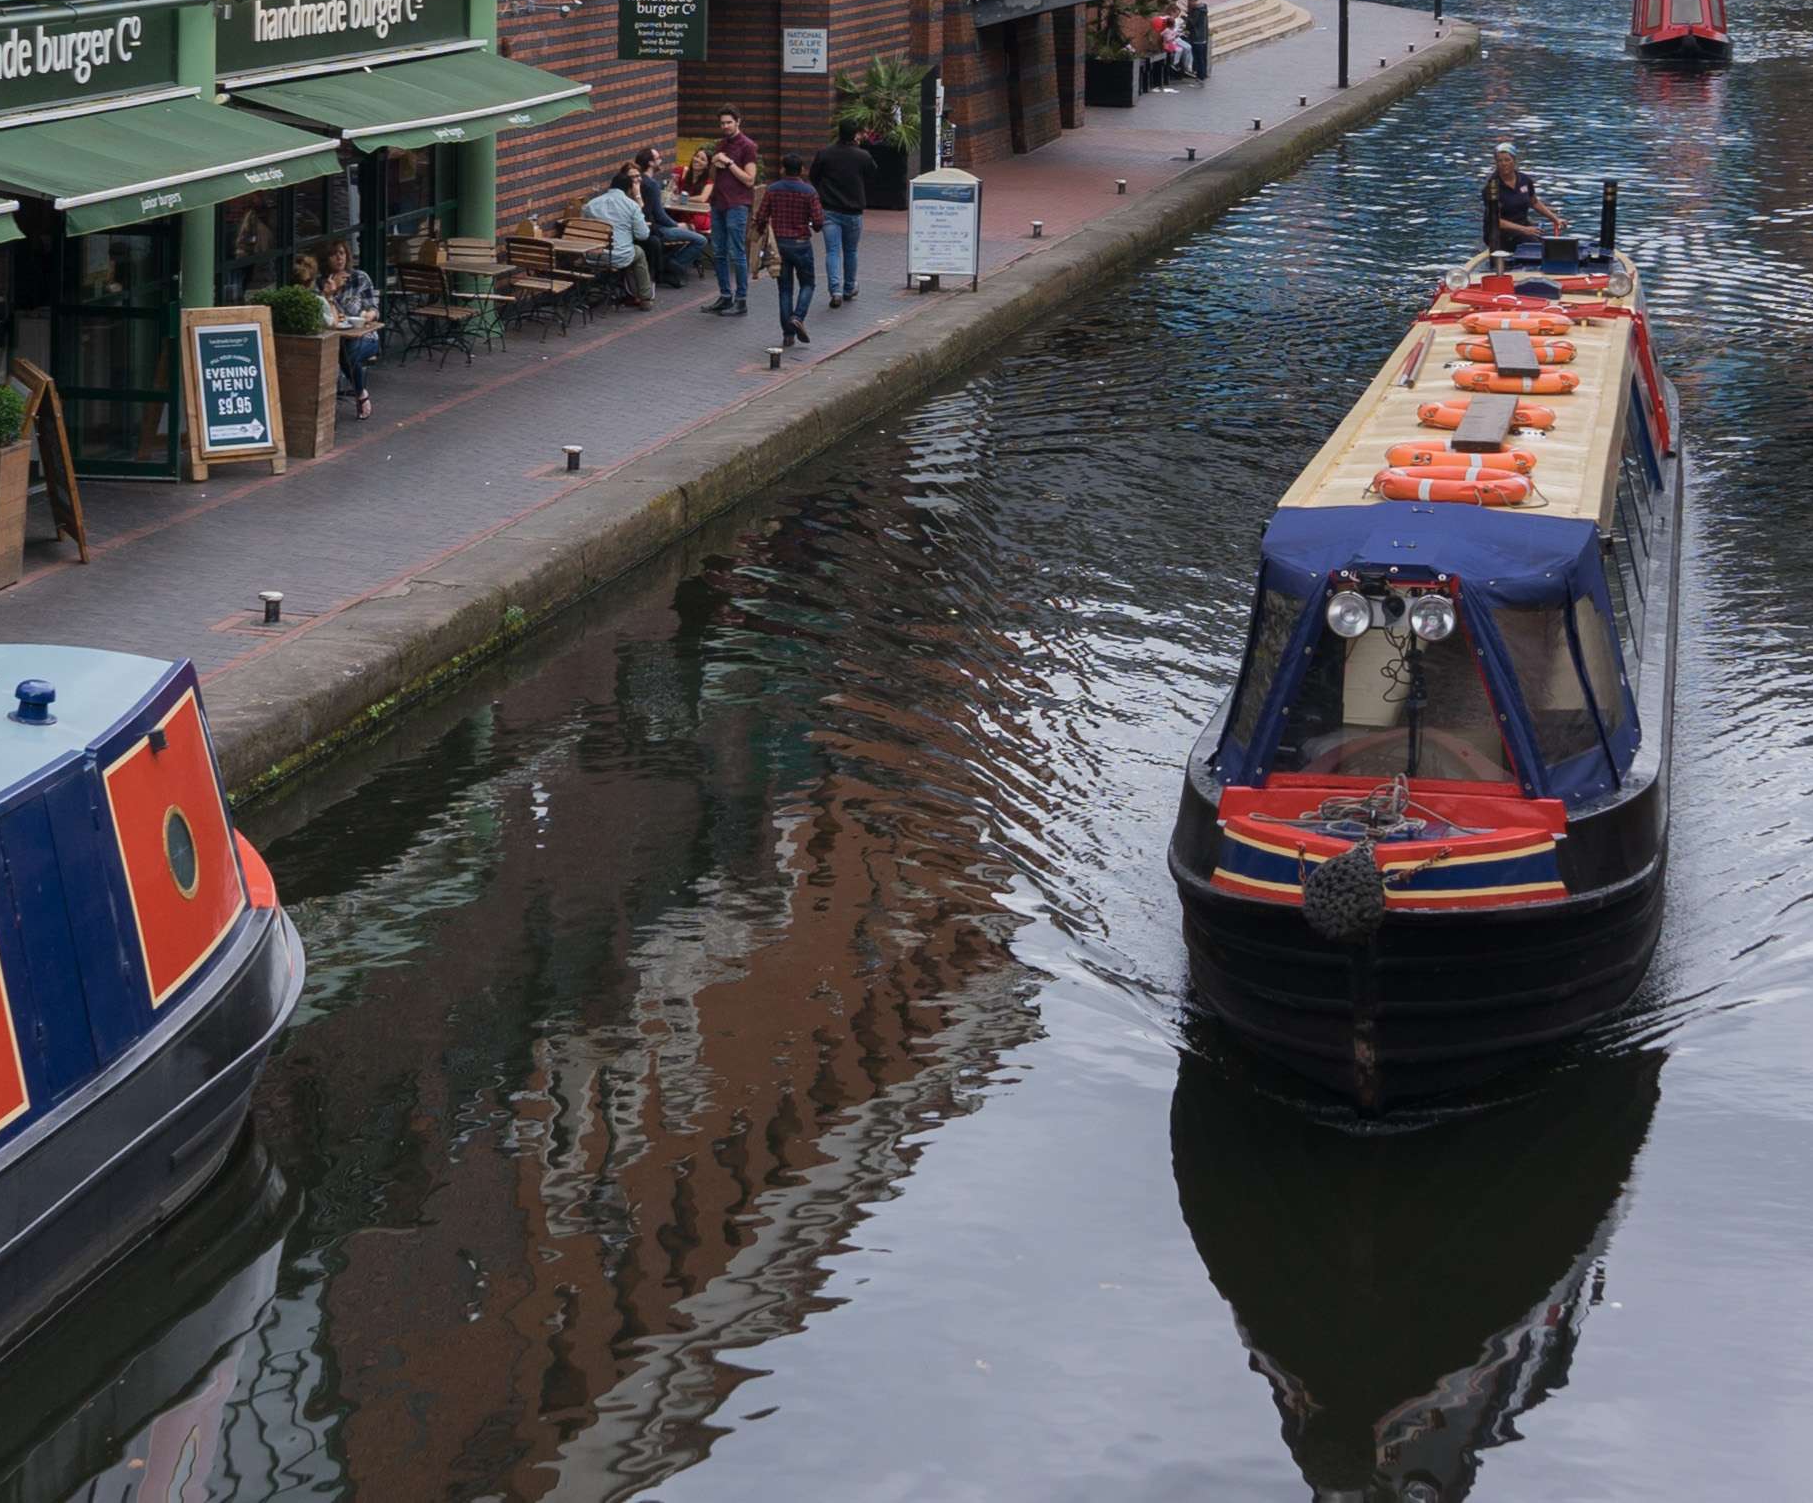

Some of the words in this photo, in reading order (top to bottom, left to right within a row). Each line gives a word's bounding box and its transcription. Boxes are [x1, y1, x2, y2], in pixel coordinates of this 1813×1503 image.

[636, 1, 681, 17] burger
[36, 25, 115, 85] burger
[205, 365, 258, 380] EVENING
[212, 378, 254, 393] MENU
[218, 397, 253, 416] £9.95
